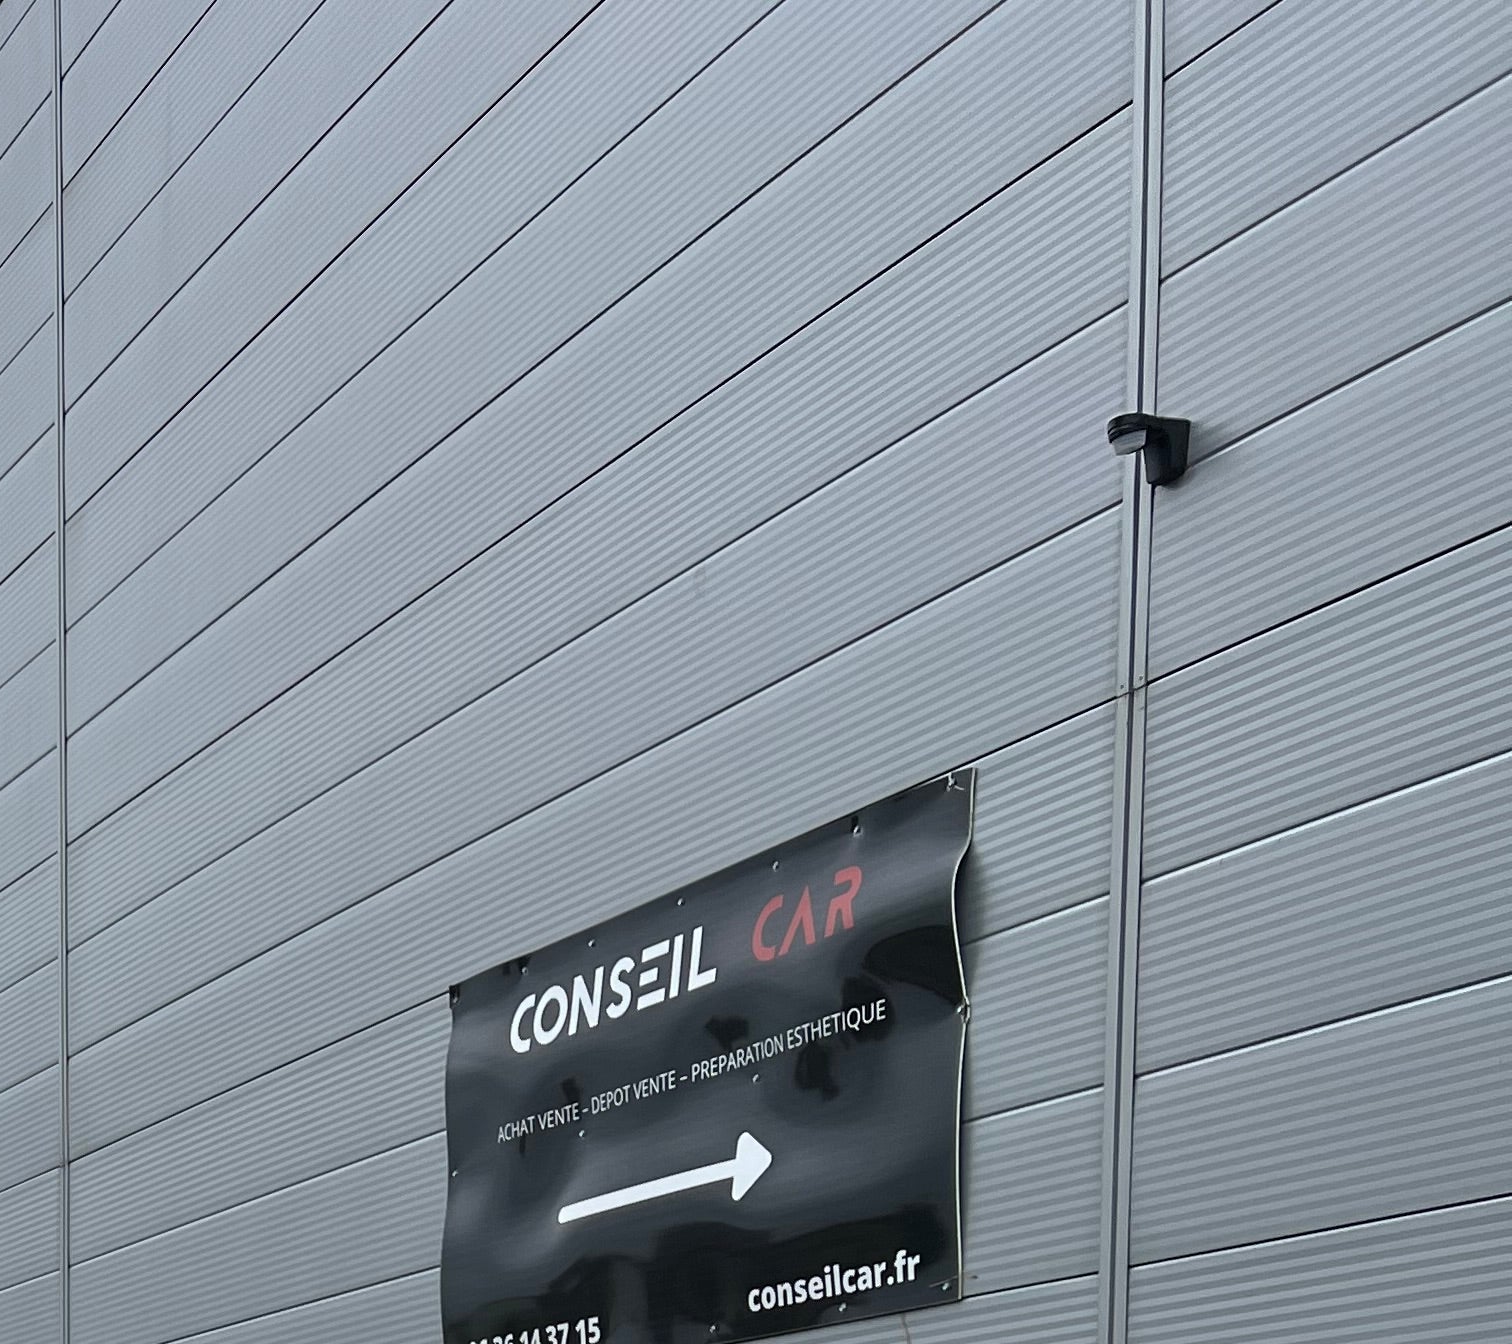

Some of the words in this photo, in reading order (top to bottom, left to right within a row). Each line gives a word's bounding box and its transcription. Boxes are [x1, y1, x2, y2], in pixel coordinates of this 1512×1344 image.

[509, 925, 717, 1054] CONSEIL
[751, 865, 863, 962] CAR
[497, 1115, 535, 1143] ACHAT
[537, 1102, 580, 1130] VENTE
[591, 1085, 630, 1115] DEPOT
[632, 1070, 676, 1100] VENTE
[691, 1033, 784, 1083] PREPARATION
[787, 998, 886, 1050] ESTHETIQUE
[747, 1249, 921, 1313] conseilcar.fr
